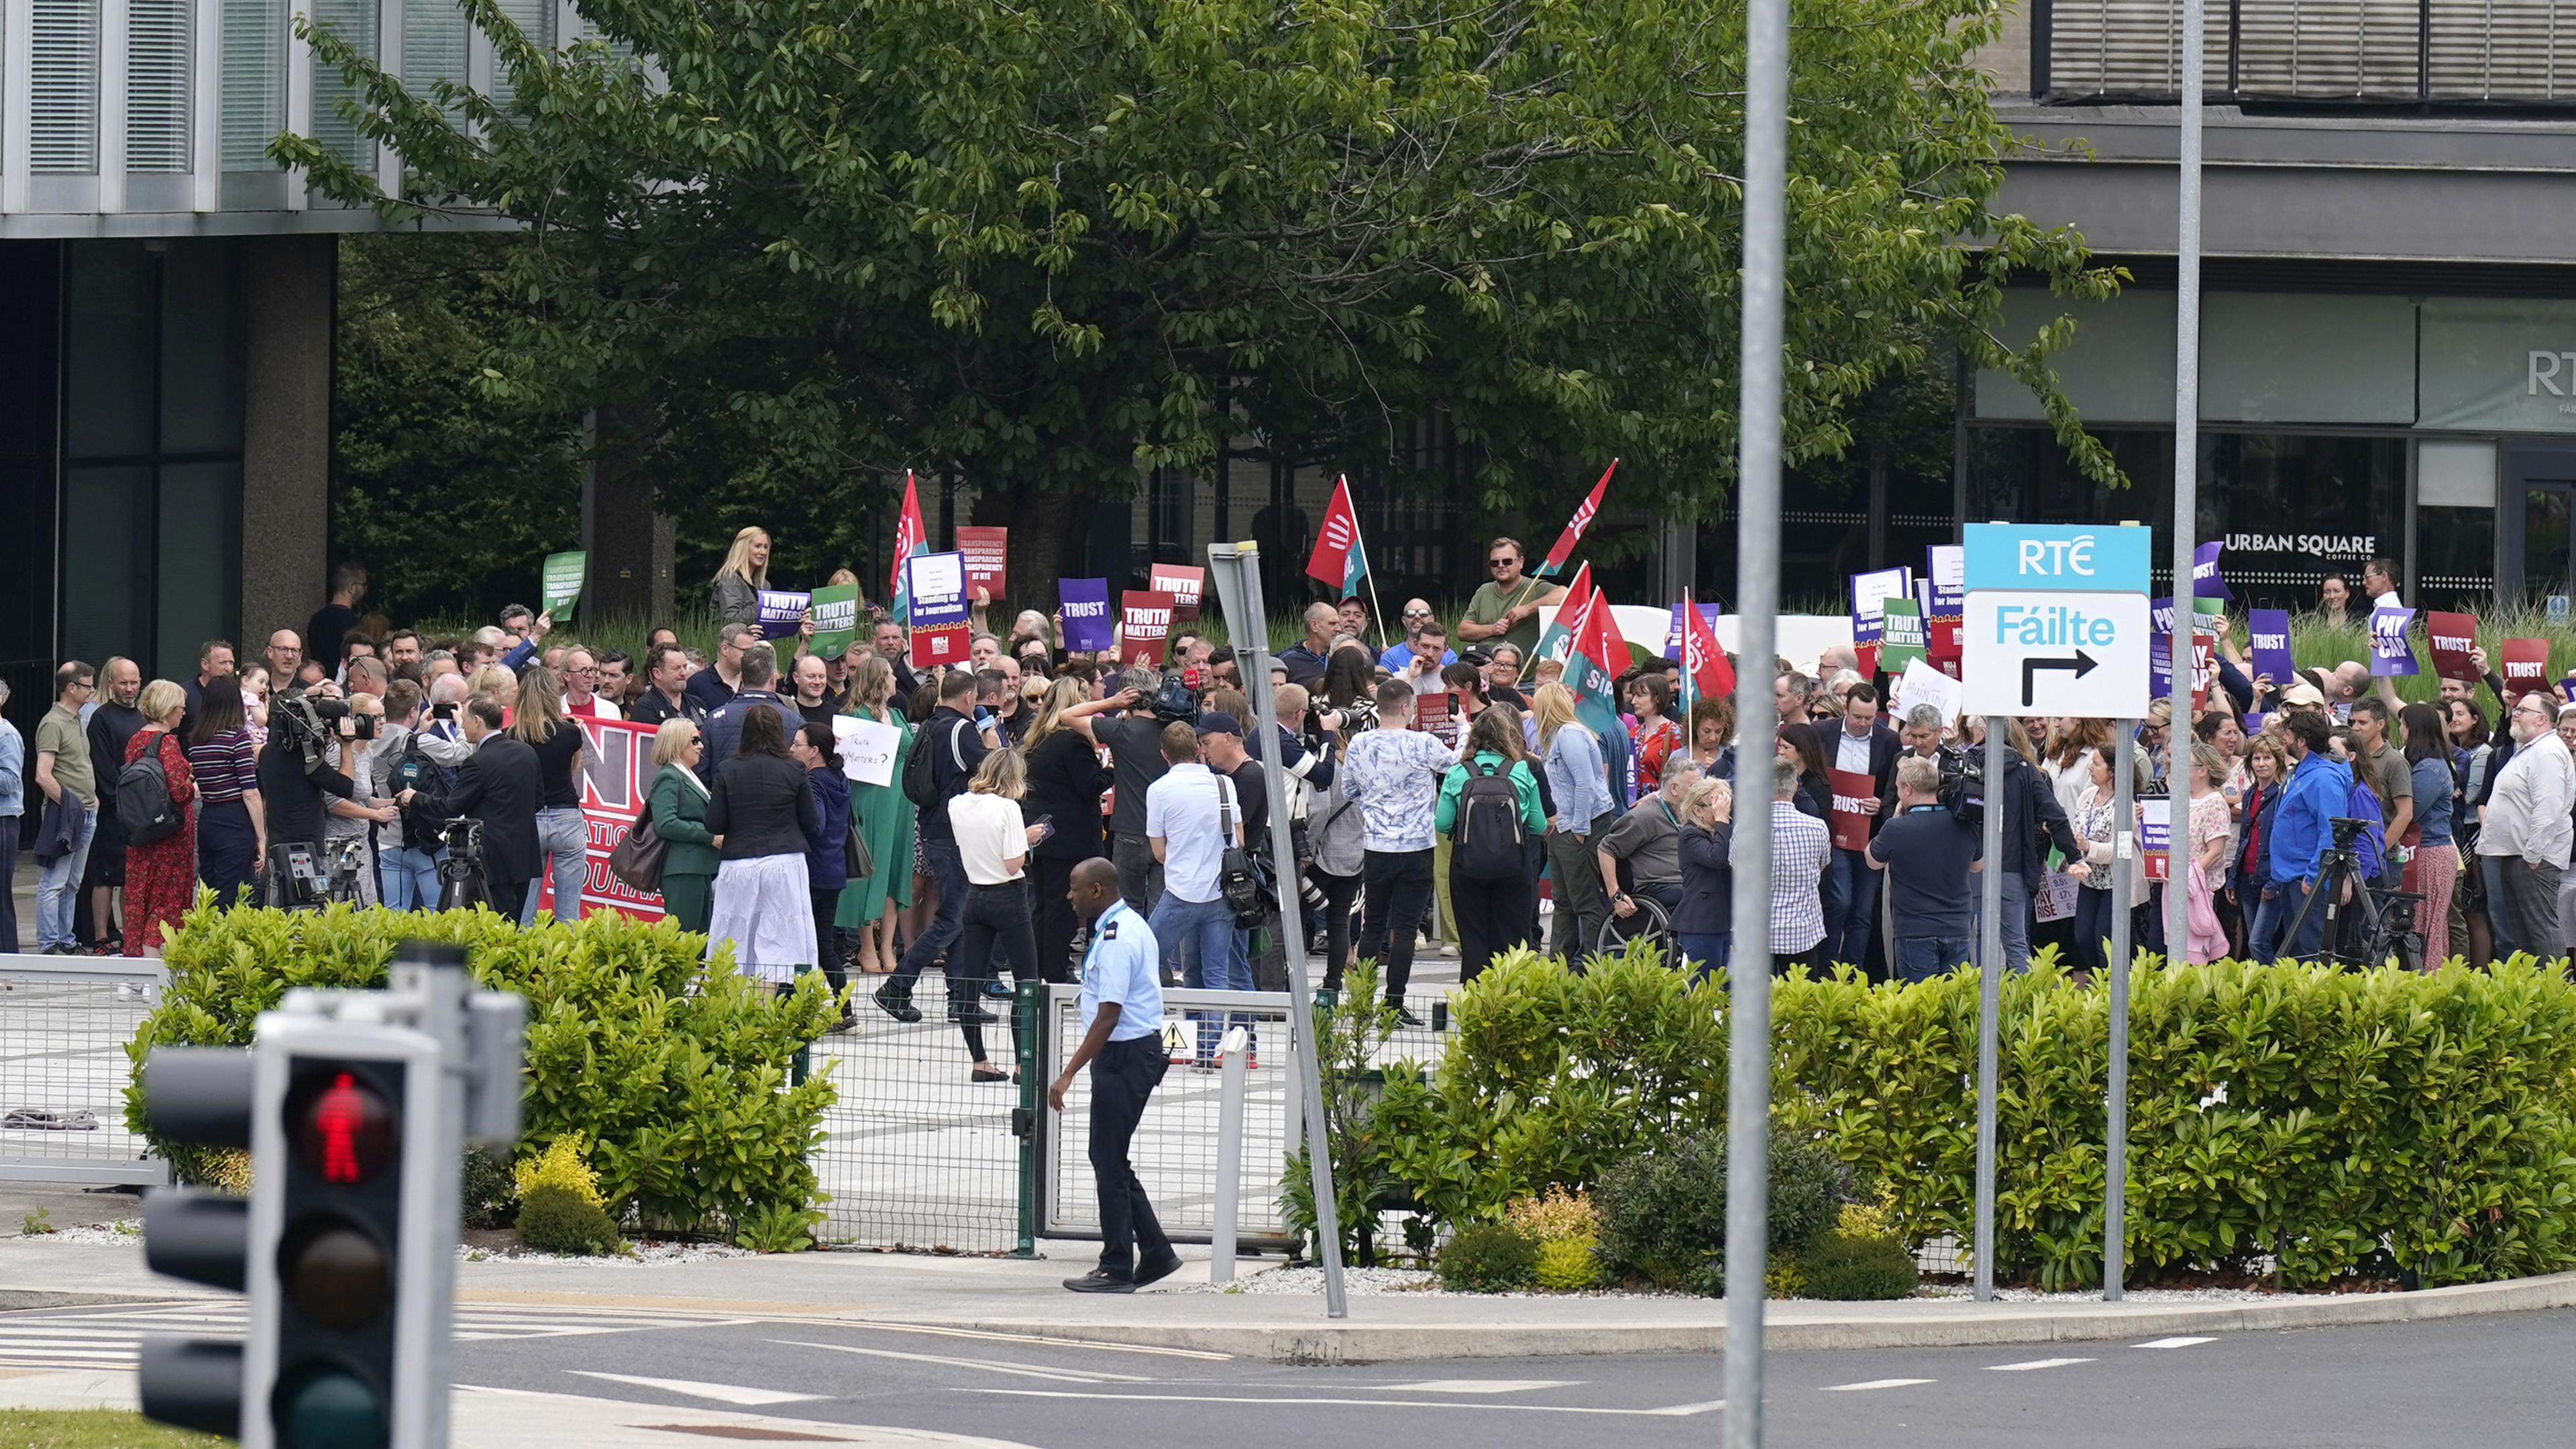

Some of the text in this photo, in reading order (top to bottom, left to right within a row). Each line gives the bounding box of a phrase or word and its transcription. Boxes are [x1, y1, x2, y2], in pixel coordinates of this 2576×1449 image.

[2528, 351, 2576, 395] RT
[2225, 533, 2375, 557] URBAN SQUARE
[965, 555, 1003, 564] RANSPARENCY
[2019, 535, 2095, 576] RTÉ
[965, 564, 1003, 572] RANSPARENCY
[2193, 561, 2215, 580] RUST
[1154, 576, 1201, 594] TRUTH
[761, 592, 808, 610] TRUTH
[917, 593, 959, 605] Standing up
[1173, 594, 1199, 605] TERS
[760, 607, 804, 619] MATTERS
[815, 599, 856, 620] TRUTH
[914, 604, 963, 617] for Journalism
[1064, 601, 1105, 618] TRUST
[1124, 607, 1171, 625] TRUTH
[815, 616, 855, 630] MATTERS
[1124, 624, 1169, 637] MATTERS
[1996, 605, 2115, 646] Fáilte
[2377, 614, 2408, 637] PAY
[931, 636, 949, 645] NUJ
[1886, 631, 1924, 644] MATTER
[2253, 633, 2286, 649] TRUST
[2432, 635, 2472, 653] TRUST
[2192, 645, 2208, 668] AY
[2378, 637, 2407, 659] CAP
[2506, 662, 2544, 678] TRUST
[1586, 669, 1613, 698] SIP
[2191, 668, 2210, 692] AP
[583, 819, 629, 847] ATIO
[2037, 904, 2057, 919] RISE
